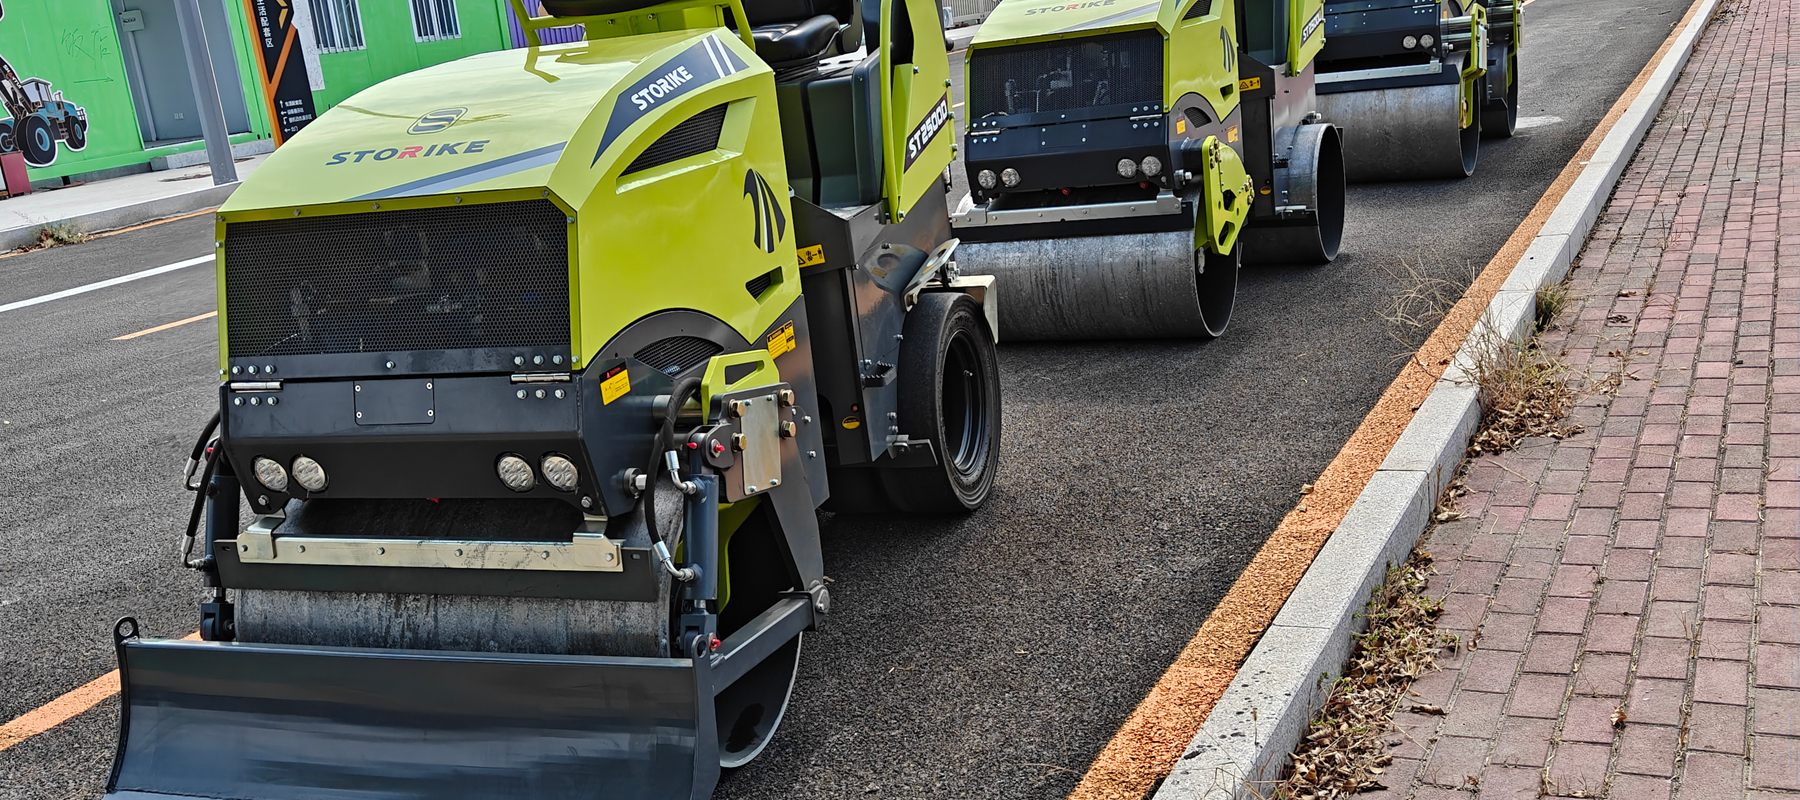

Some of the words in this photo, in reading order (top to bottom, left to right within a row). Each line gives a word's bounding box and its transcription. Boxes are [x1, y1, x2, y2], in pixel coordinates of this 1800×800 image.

[1024, 0, 1116, 16] STORIKE
[631, 65, 694, 111] STORIKE
[325, 139, 491, 166] STORIKE
